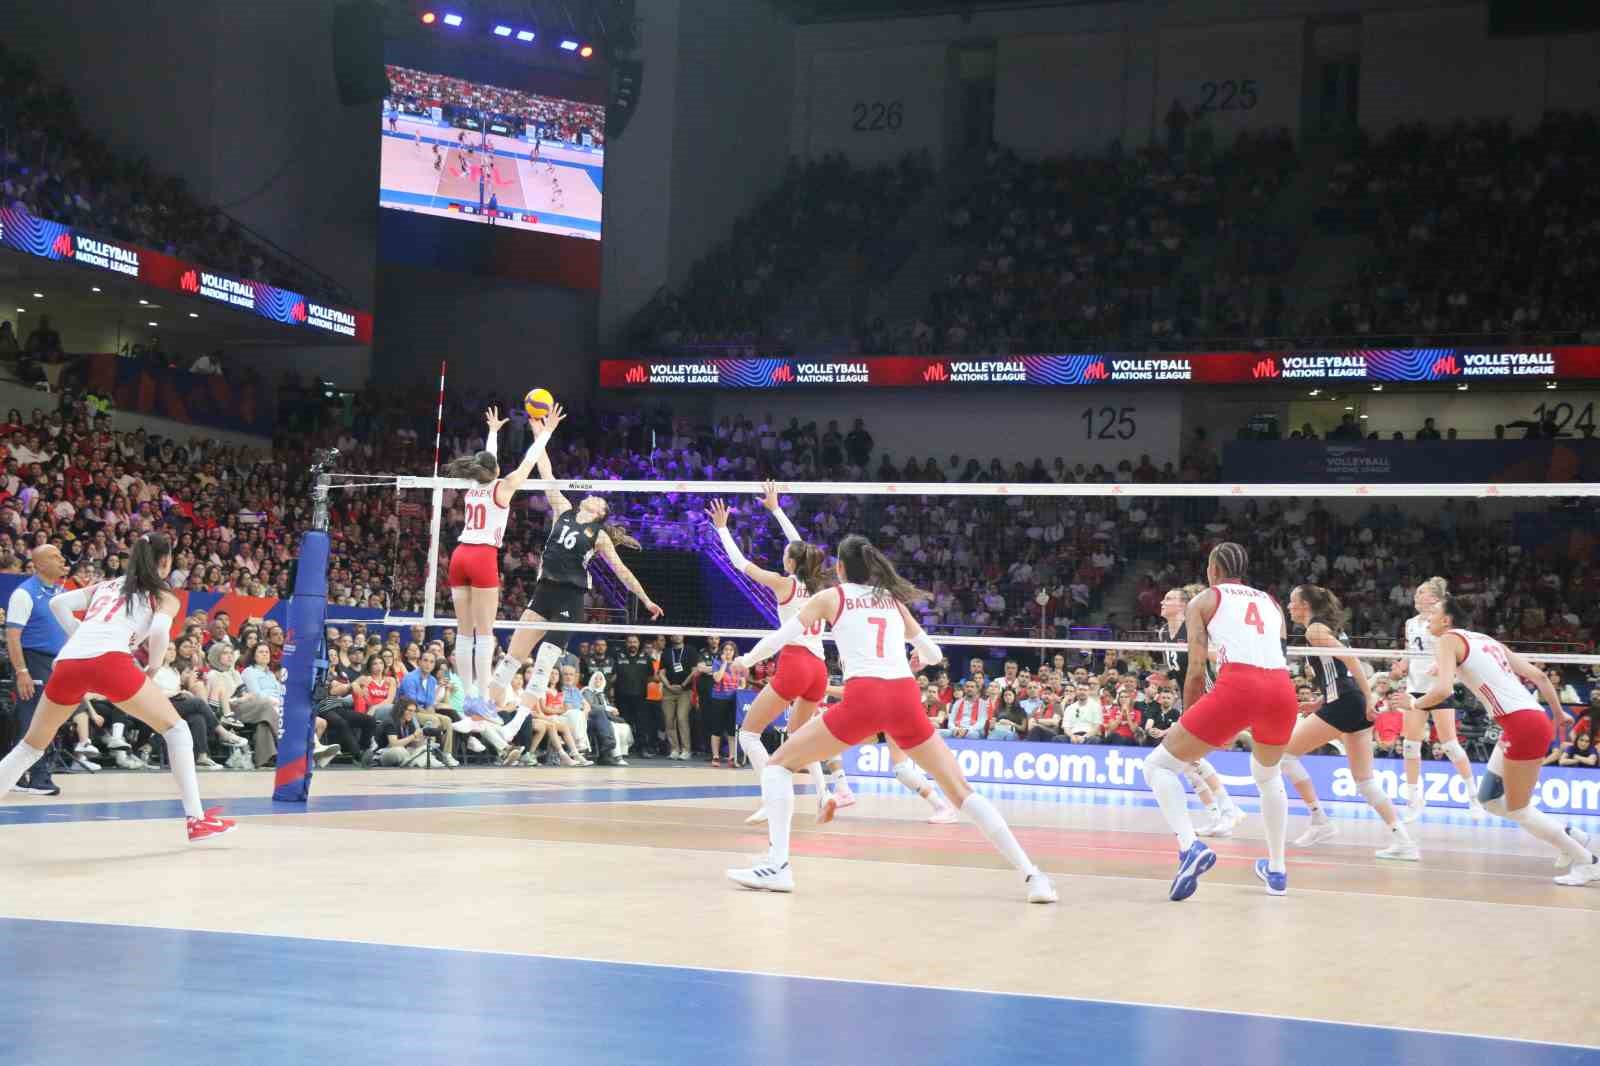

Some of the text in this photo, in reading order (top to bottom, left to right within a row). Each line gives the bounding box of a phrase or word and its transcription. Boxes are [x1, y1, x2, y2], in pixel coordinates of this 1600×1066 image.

[1200, 80, 1258, 111] 225
[852, 102, 903, 132] 226
[76, 236, 139, 266] VOLLEYBALL
[75, 250, 139, 277] NATIONS LEAGUE
[201, 272, 255, 298] VOLLEYBALL
[200, 285, 254, 309] NATIONS LEAGUE
[308, 303, 356, 326] VOLLEYBALL
[308, 316, 356, 336] NATIONS LEAGUE
[649, 364, 719, 375] VOLLEYBALL
[796, 363, 869, 374] VOLLEYBALL
[950, 361, 1027, 372] VOLLEYBALL
[1111, 359, 1192, 371] VOLLEYBALL
[1282, 356, 1367, 368] VOLLEYBALL
[1463, 353, 1555, 365] VOLLEYBALL
[649, 375, 719, 383] NATIONS LEAGUE
[796, 375, 869, 383] NATIONS LEAGUE
[950, 372, 1027, 382] NATIONS LEAGUE
[1111, 371, 1192, 380] NATIONS LEAGUE
[1282, 369, 1367, 378] NATIONS LEAGUE
[1463, 366, 1555, 375] NATIONS LEAGUE
[1081, 407, 1137, 440] 125
[1533, 401, 1597, 437] 124
[465, 503, 487, 530] 20
[557, 525, 579, 550] 16
[1244, 602, 1265, 635] 4
[867, 617, 887, 658] 7
